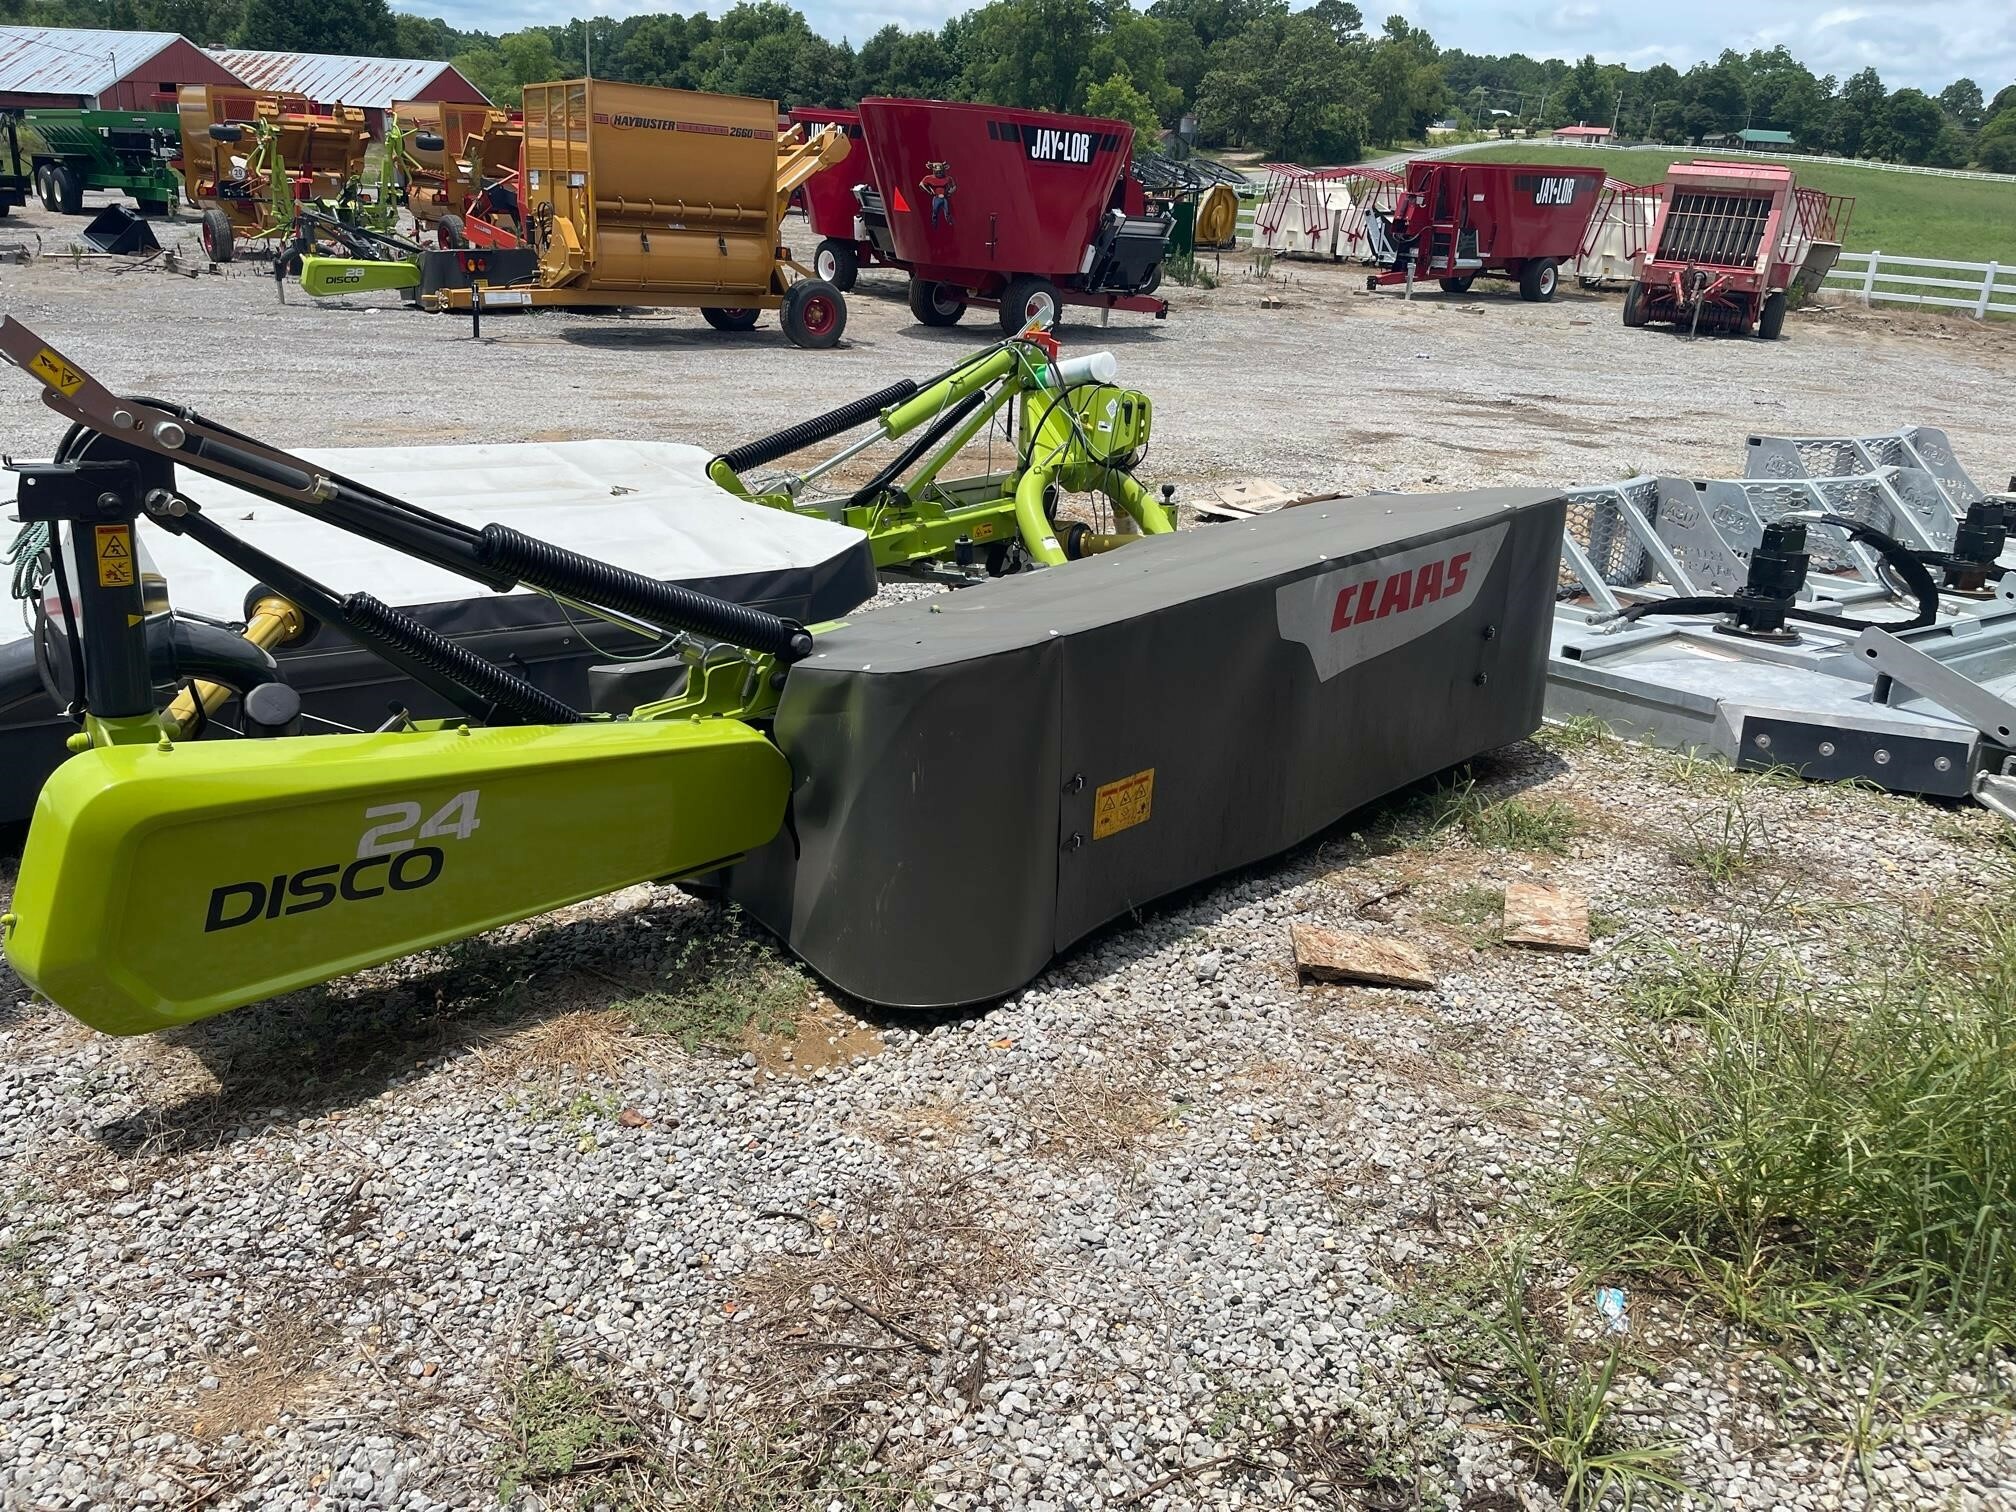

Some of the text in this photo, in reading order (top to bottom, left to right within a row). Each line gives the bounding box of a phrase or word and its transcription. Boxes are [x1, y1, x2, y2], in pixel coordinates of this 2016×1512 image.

[613, 115, 754, 139] HAYBUSTER 2660
[325, 276, 360, 285] DISCO
[345, 268, 365, 277] 28
[1330, 552, 1472, 633] CLAAS
[356, 789, 480, 859] 24
[204, 846, 444, 933] DISCO
